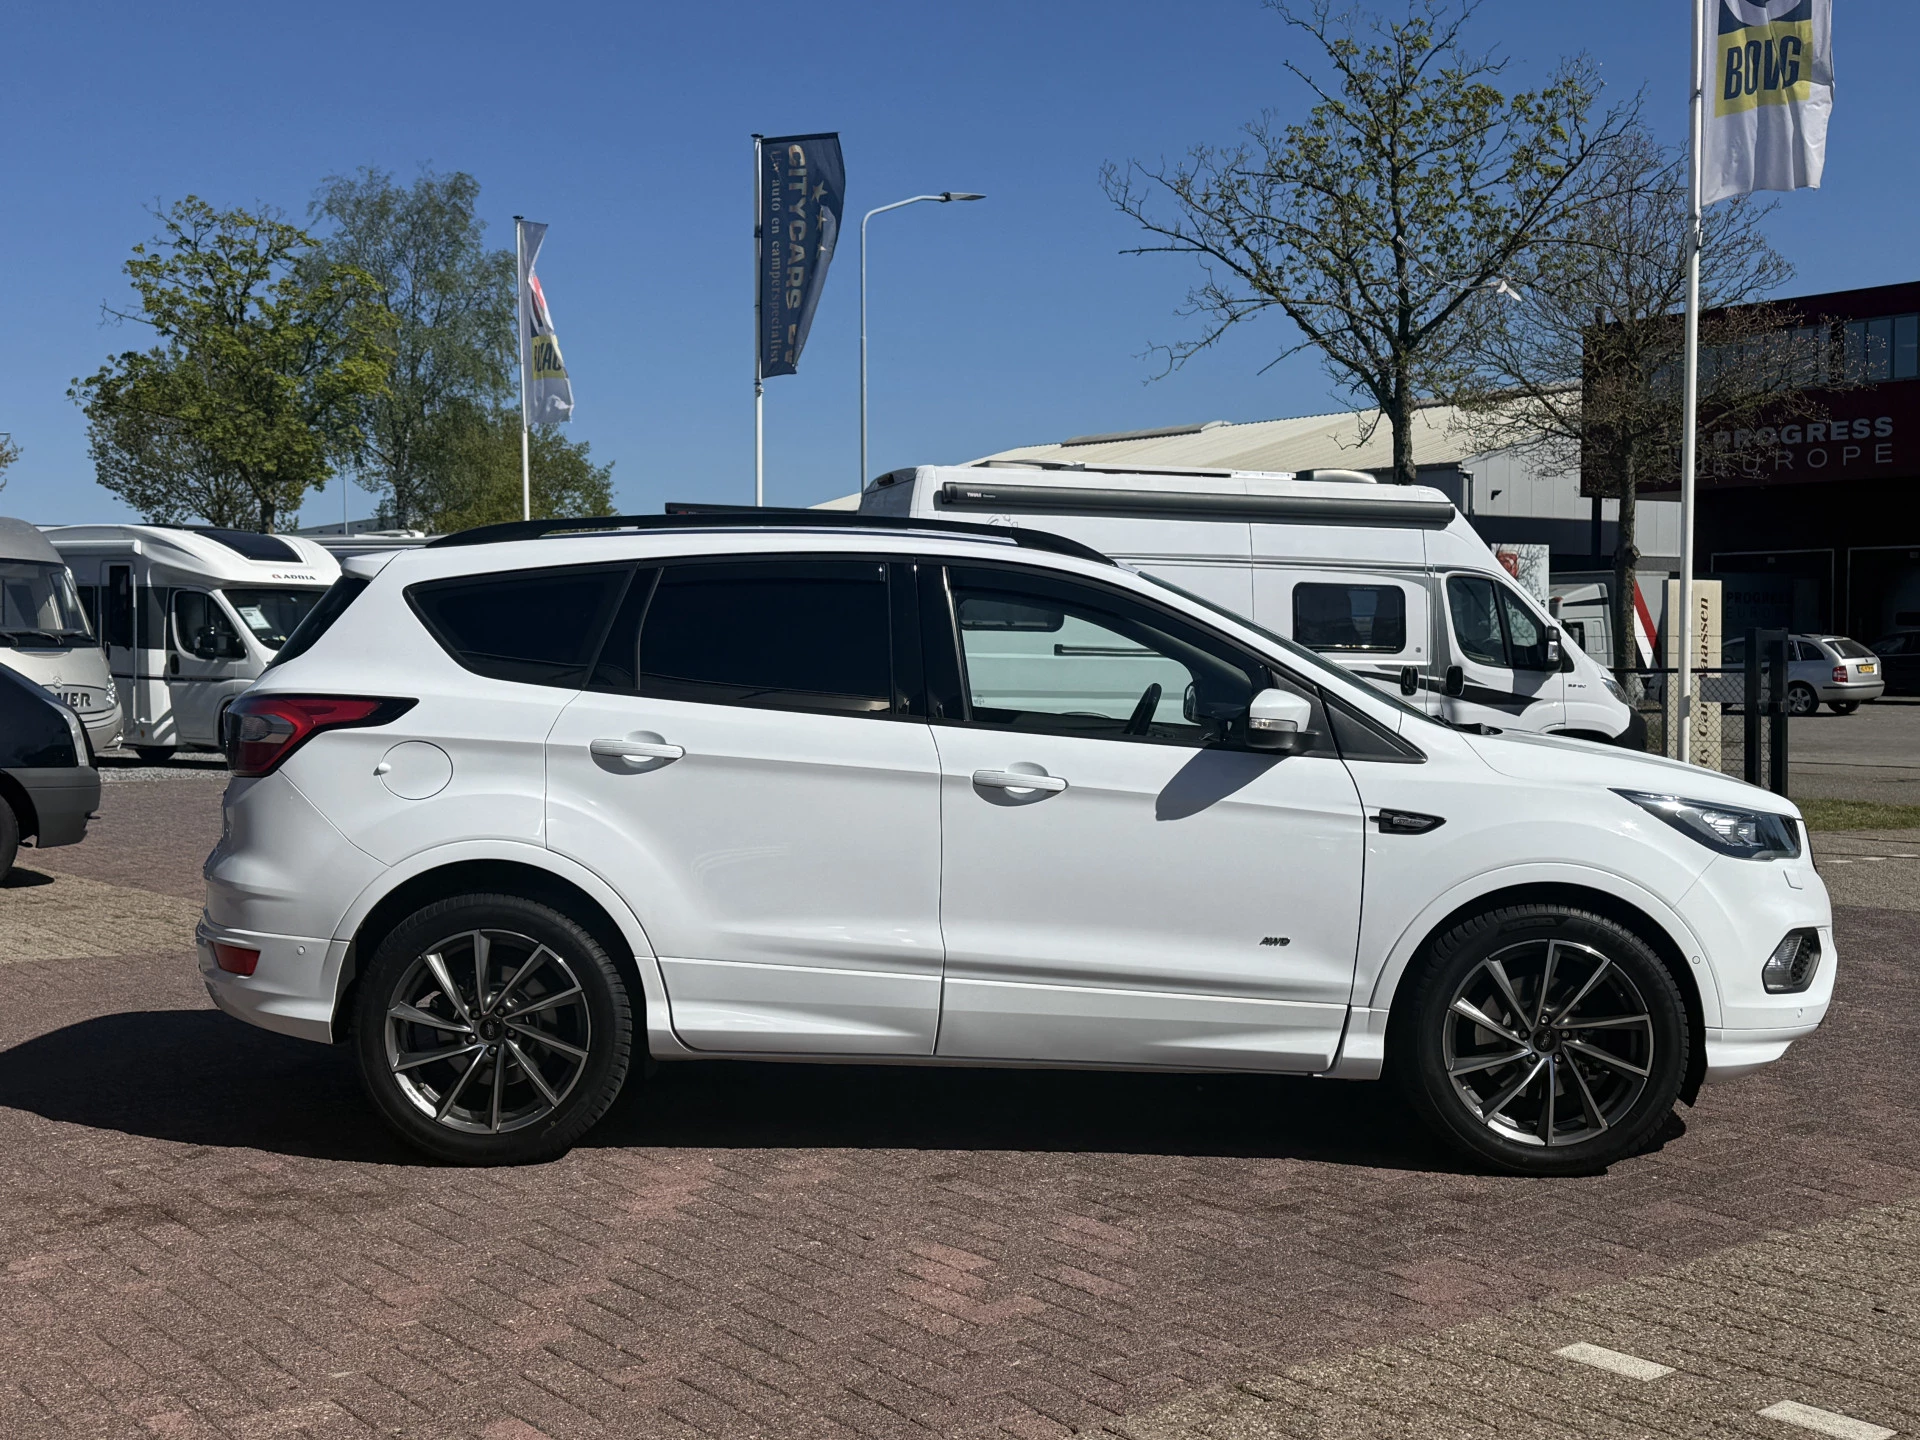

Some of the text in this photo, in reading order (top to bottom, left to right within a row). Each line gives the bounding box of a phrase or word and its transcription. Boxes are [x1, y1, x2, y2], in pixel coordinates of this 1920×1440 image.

[1723, 35, 1802, 100] BOVG
[771, 180, 782, 211] auto
[771, 218, 781, 234] en
[786, 144, 807, 309] CITYCARS
[769, 241, 782, 363] camperspecialist
[1713, 416, 1894, 450] PROGRESS
[1258, 936, 1291, 947] AWD
